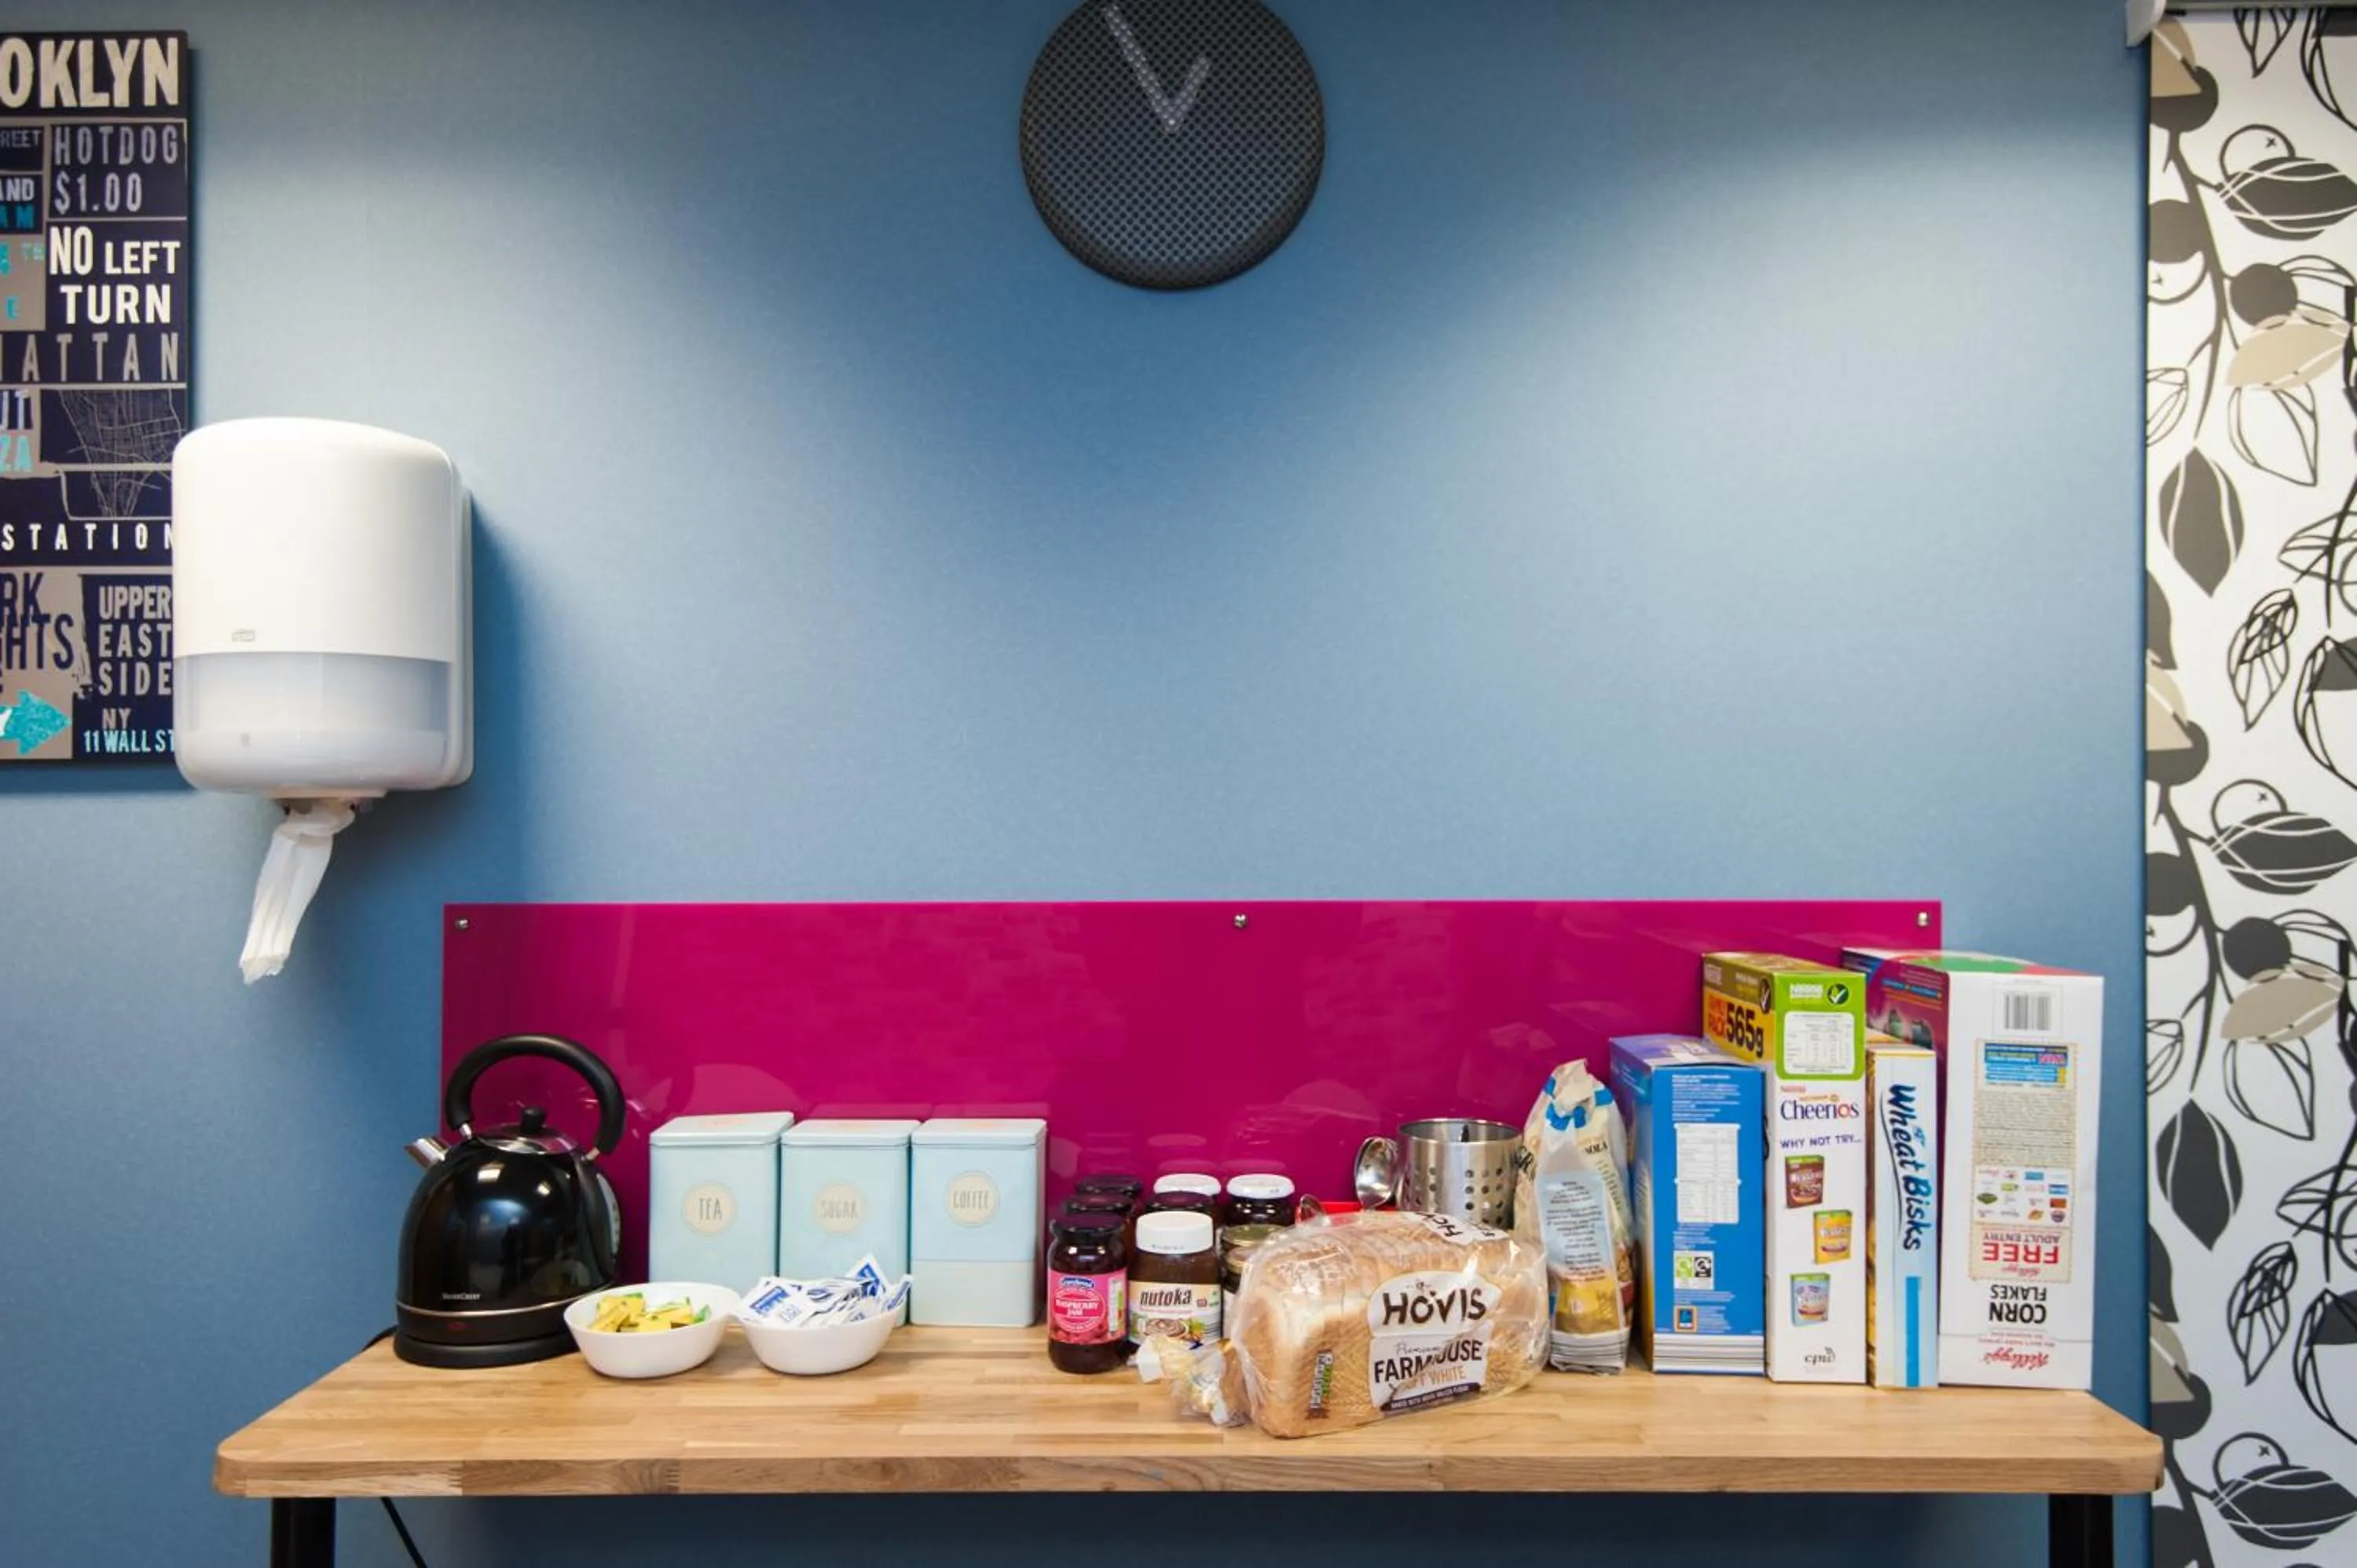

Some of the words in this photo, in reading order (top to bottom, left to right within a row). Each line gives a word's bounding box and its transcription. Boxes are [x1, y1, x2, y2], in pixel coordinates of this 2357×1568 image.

[54, 125, 178, 165] HOTDOG
[54, 172, 142, 214] $1.00
[49, 226, 93, 275] NO
[105, 241, 181, 274] LEFT
[60, 284, 170, 324] TURN
[0, 333, 179, 383] ATTAN
[99, 585, 172, 619] UPPER
[99, 623, 172, 658] EAST
[99, 662, 171, 696] SIDE
[102, 709, 131, 729] NY
[84, 730, 100, 752] 11
[103, 731, 151, 752] WALL
[1727, 1001, 1764, 1058] 565g
[1780, 1099, 1860, 1120] Cheerios
[1780, 1138, 1805, 1149] WHY
[1809, 1135, 1831, 1146] NOT
[1887, 1084, 1926, 1171] Wheat
[698, 1197, 723, 1221] TEA
[821, 1200, 859, 1220] SUGAR
[952, 1191, 991, 1210] COFFEE
[1901, 1176, 1934, 1251] Bisks
[1981, 1242, 2059, 1264] FREE
[1140, 1288, 1193, 1306] nutoka
[1382, 1288, 1486, 1326] HOVIS
[1990, 1284, 2047, 1301] FLAKES
[1989, 1302, 2047, 1324] CORN
